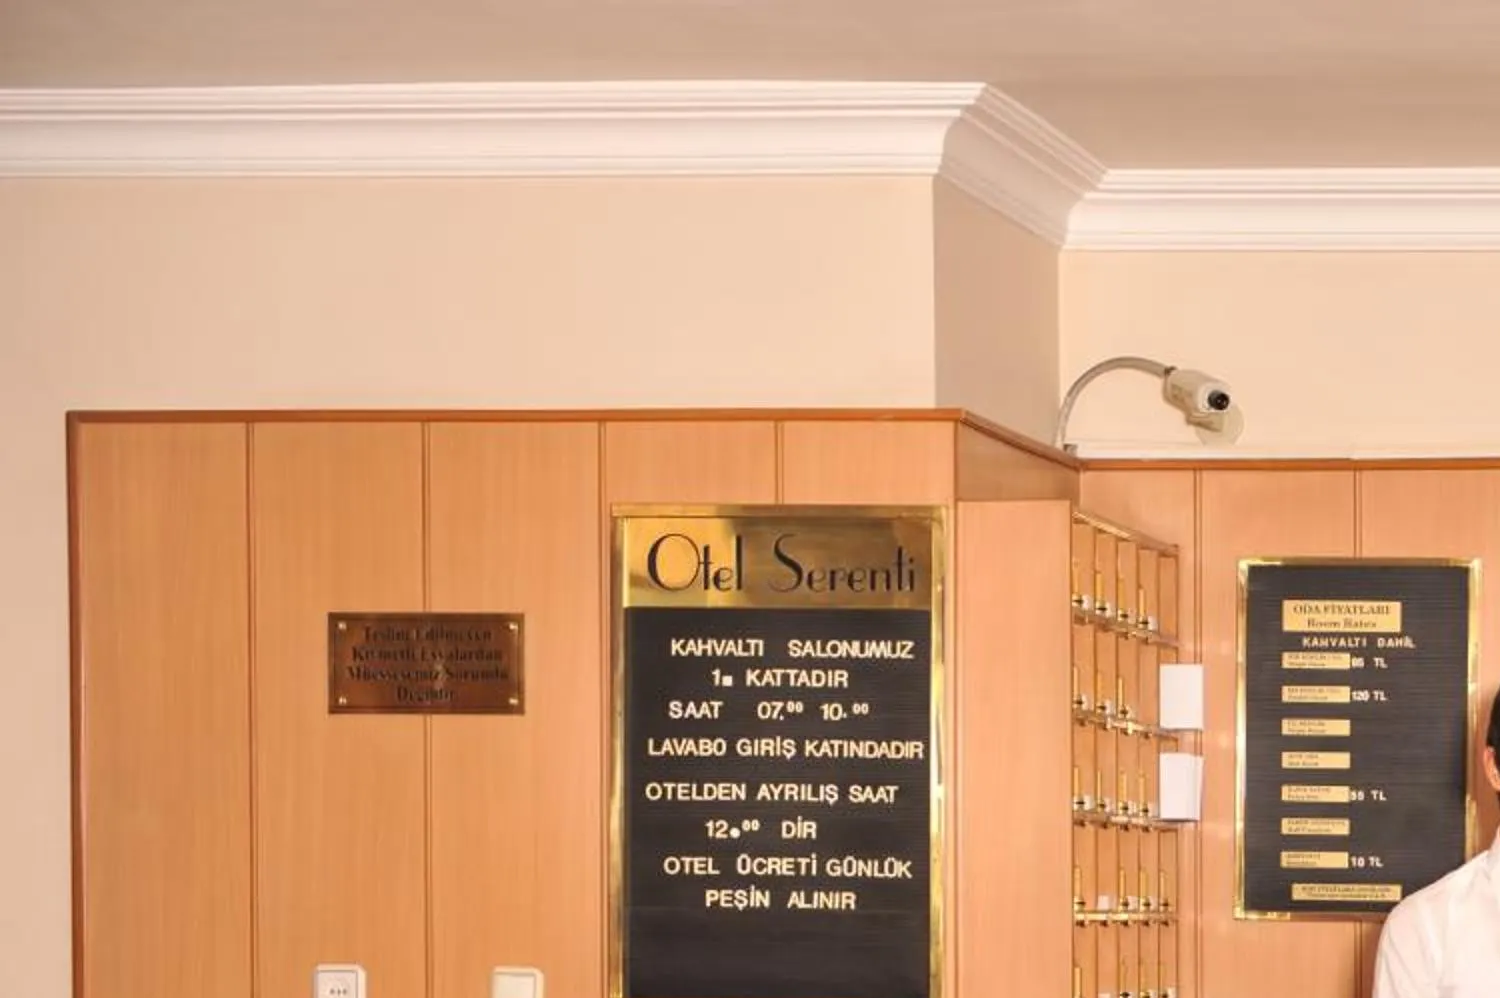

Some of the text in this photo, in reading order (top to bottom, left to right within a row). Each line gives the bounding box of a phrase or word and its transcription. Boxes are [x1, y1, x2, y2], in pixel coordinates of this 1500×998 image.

[647, 533, 915, 593] Otel Serenti
[1292, 604, 1321, 615] ODA
[672, 639, 914, 658] KAHVALTI SALONUMUZ
[1302, 636, 1367, 648] KAHVALTI
[1373, 656, 1388, 669] TL
[746, 669, 848, 688] KATTADIR
[1372, 690, 1388, 701] TL
[669, 701, 723, 719] SAAT
[649, 738, 726, 756] LAVABO
[805, 740, 924, 759] KATINDADIR
[646, 783, 898, 805] OTELDEN AYRILIŞ SAAT
[1370, 790, 1387, 801] TL
[782, 816, 816, 839] DİR
[664, 853, 912, 878] OTEL ÜCRETİ GÜNLÜK
[1350, 856, 1384, 868] 10 TL
[706, 885, 856, 910] PEŞİN ALINIR
